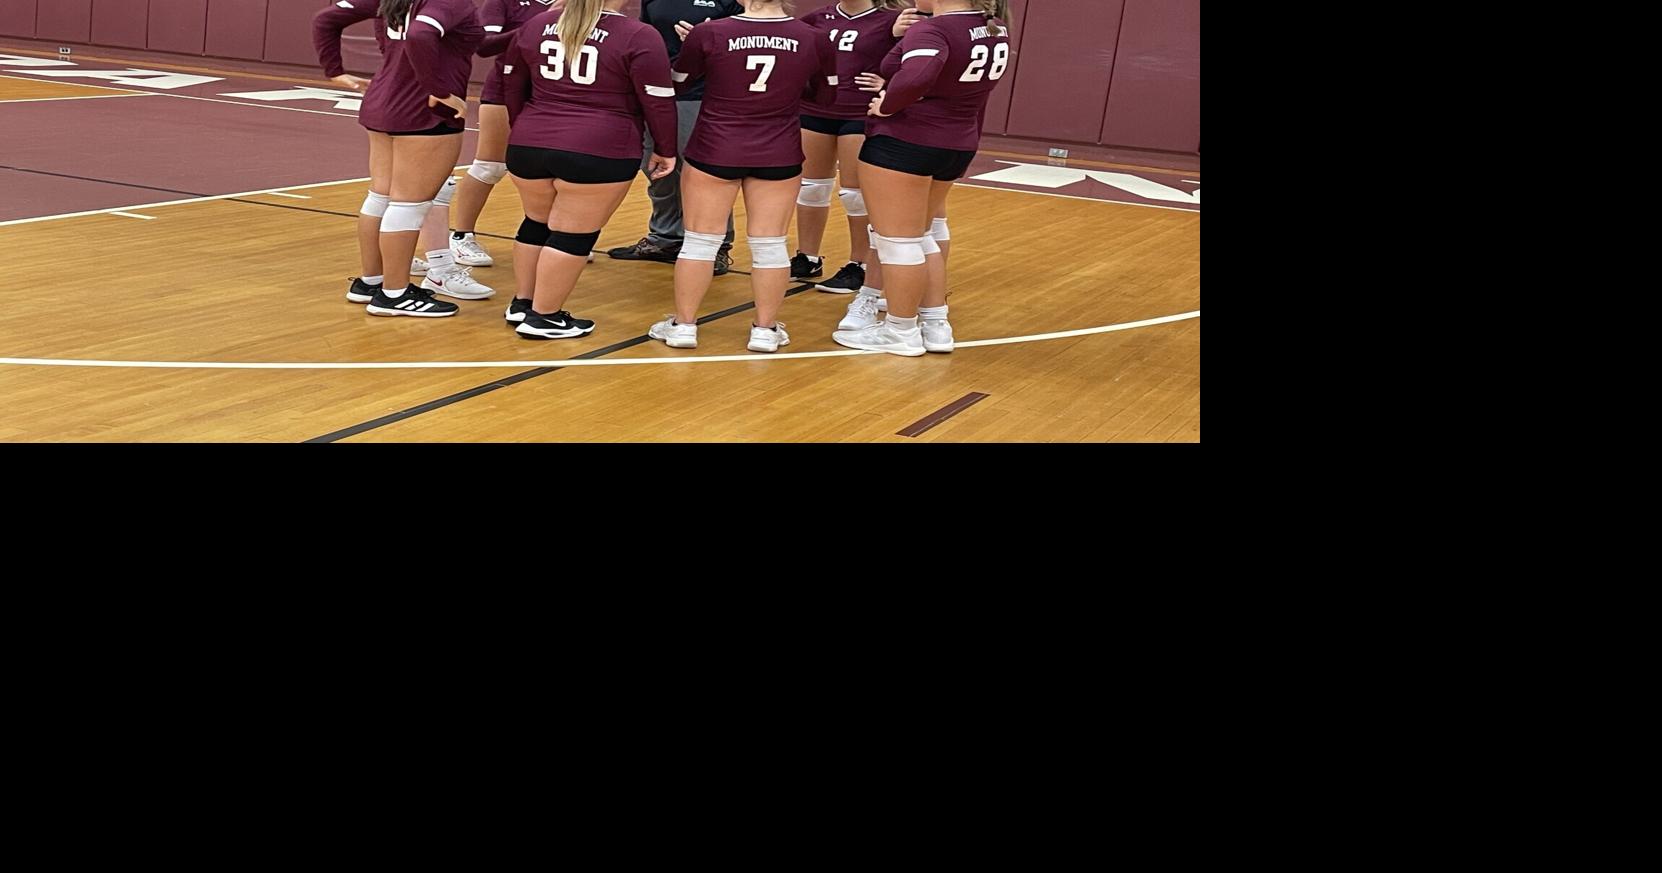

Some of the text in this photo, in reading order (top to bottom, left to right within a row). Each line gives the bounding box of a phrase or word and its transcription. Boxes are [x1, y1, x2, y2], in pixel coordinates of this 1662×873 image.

[539, 40, 599, 85] 30
[728, 36, 799, 52] MONUMENT
[959, 42, 1009, 82] 28
[746, 55, 776, 92] 7
